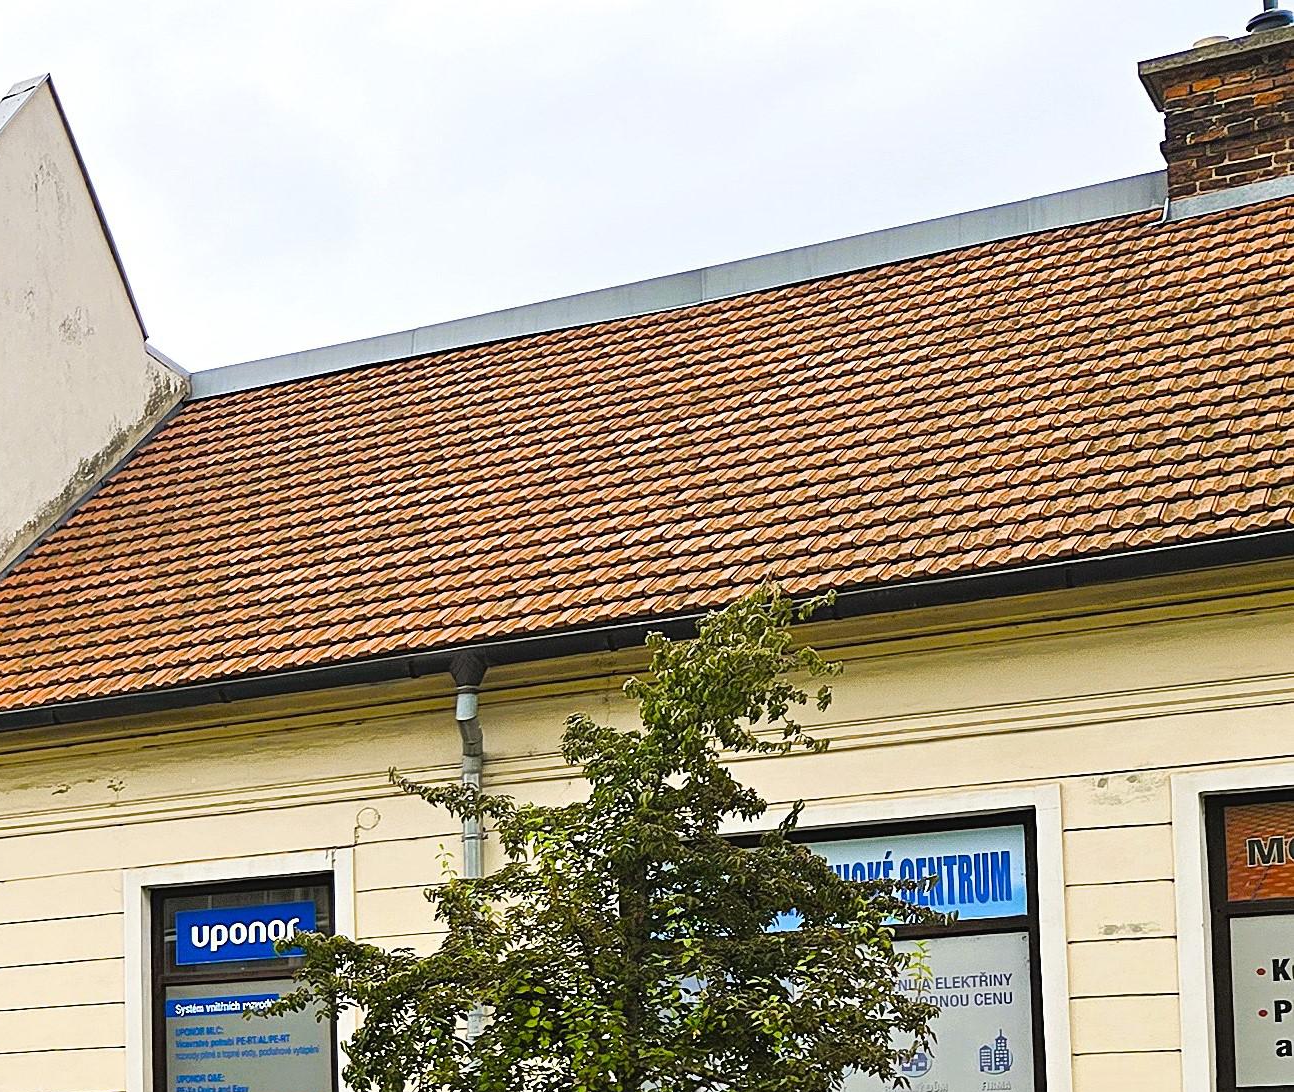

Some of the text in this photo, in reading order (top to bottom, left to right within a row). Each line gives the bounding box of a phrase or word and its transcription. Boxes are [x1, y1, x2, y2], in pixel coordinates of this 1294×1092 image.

[191, 917, 300, 952] uponor
[935, 971, 1013, 991] ELEKTŘINY
[973, 991, 1013, 1006] CENU
[175, 1003, 204, 1017] Systém
[981, 1081, 1012, 1092] FIRMA
